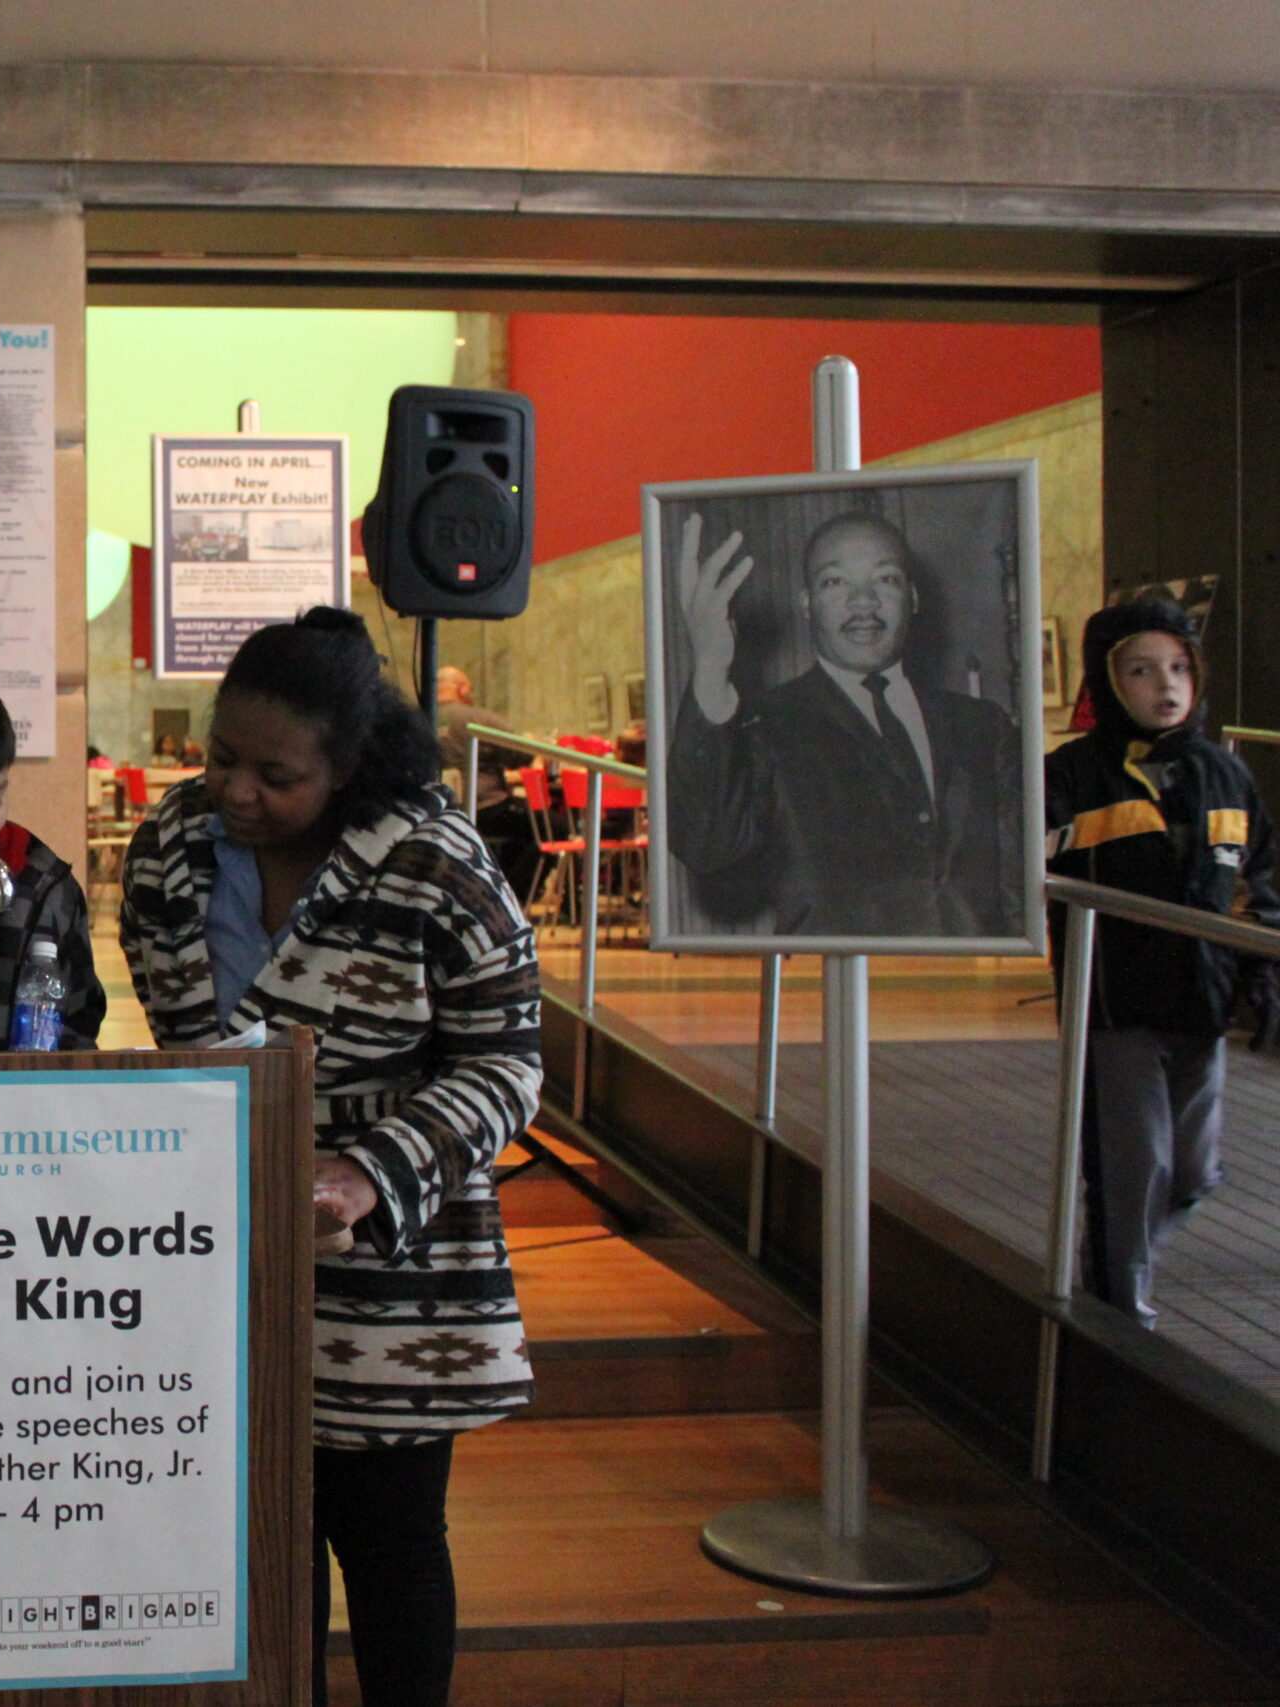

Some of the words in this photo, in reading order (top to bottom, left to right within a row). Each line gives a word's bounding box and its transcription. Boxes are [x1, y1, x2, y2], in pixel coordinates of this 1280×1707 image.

[177, 456, 242, 468] COMING
[248, 456, 264, 468] IN
[235, 477, 268, 488] New
[175, 493, 267, 506] WATERPLAY
[271, 492, 328, 505] Exhibit!
[175, 622, 232, 630] WATERPLAY
[36, 1211, 214, 1257] Words
[16, 1277, 141, 1330] King
[12, 1367, 71, 1395] and
[87, 1365, 144, 1400] join
[159, 1373, 192, 1391] us
[17, 1407, 164, 1445] speeches
[177, 1405, 208, 1434] of
[74, 1452, 153, 1485] King,
[167, 1450, 201, 1477] Jr.
[22, 1497, 40, 1522] 4
[55, 1503, 103, 1529] pm
[9, 1643, 28, 1651] your
[31, 1641, 68, 1650] weekend
[71, 1639, 82, 1648] off
[84, 1640, 92, 1648] to
[102, 1639, 121, 1648] good
